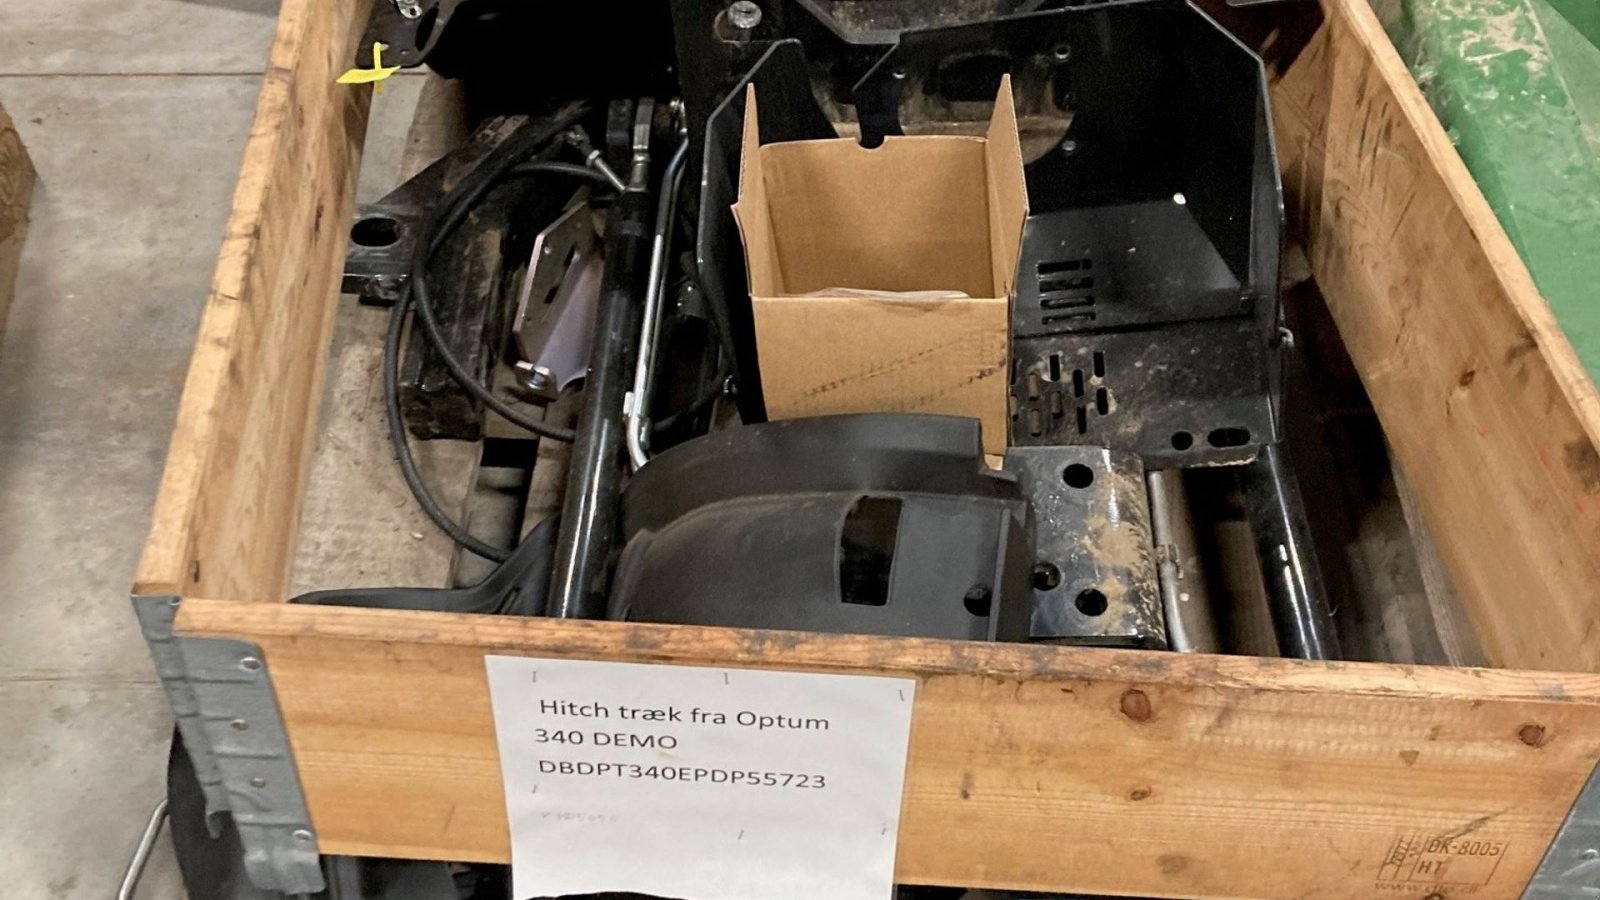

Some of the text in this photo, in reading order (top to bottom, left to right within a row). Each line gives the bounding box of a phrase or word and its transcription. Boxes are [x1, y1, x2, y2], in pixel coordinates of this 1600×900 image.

[539, 699, 830, 731] Hitch træk fra Optum
[535, 728, 678, 750] 340 DEMO
[539, 759, 827, 789] DBDPT340EPDP55723
[1427, 838, 1503, 857] DK-8005
[1417, 860, 1444, 874] HT
